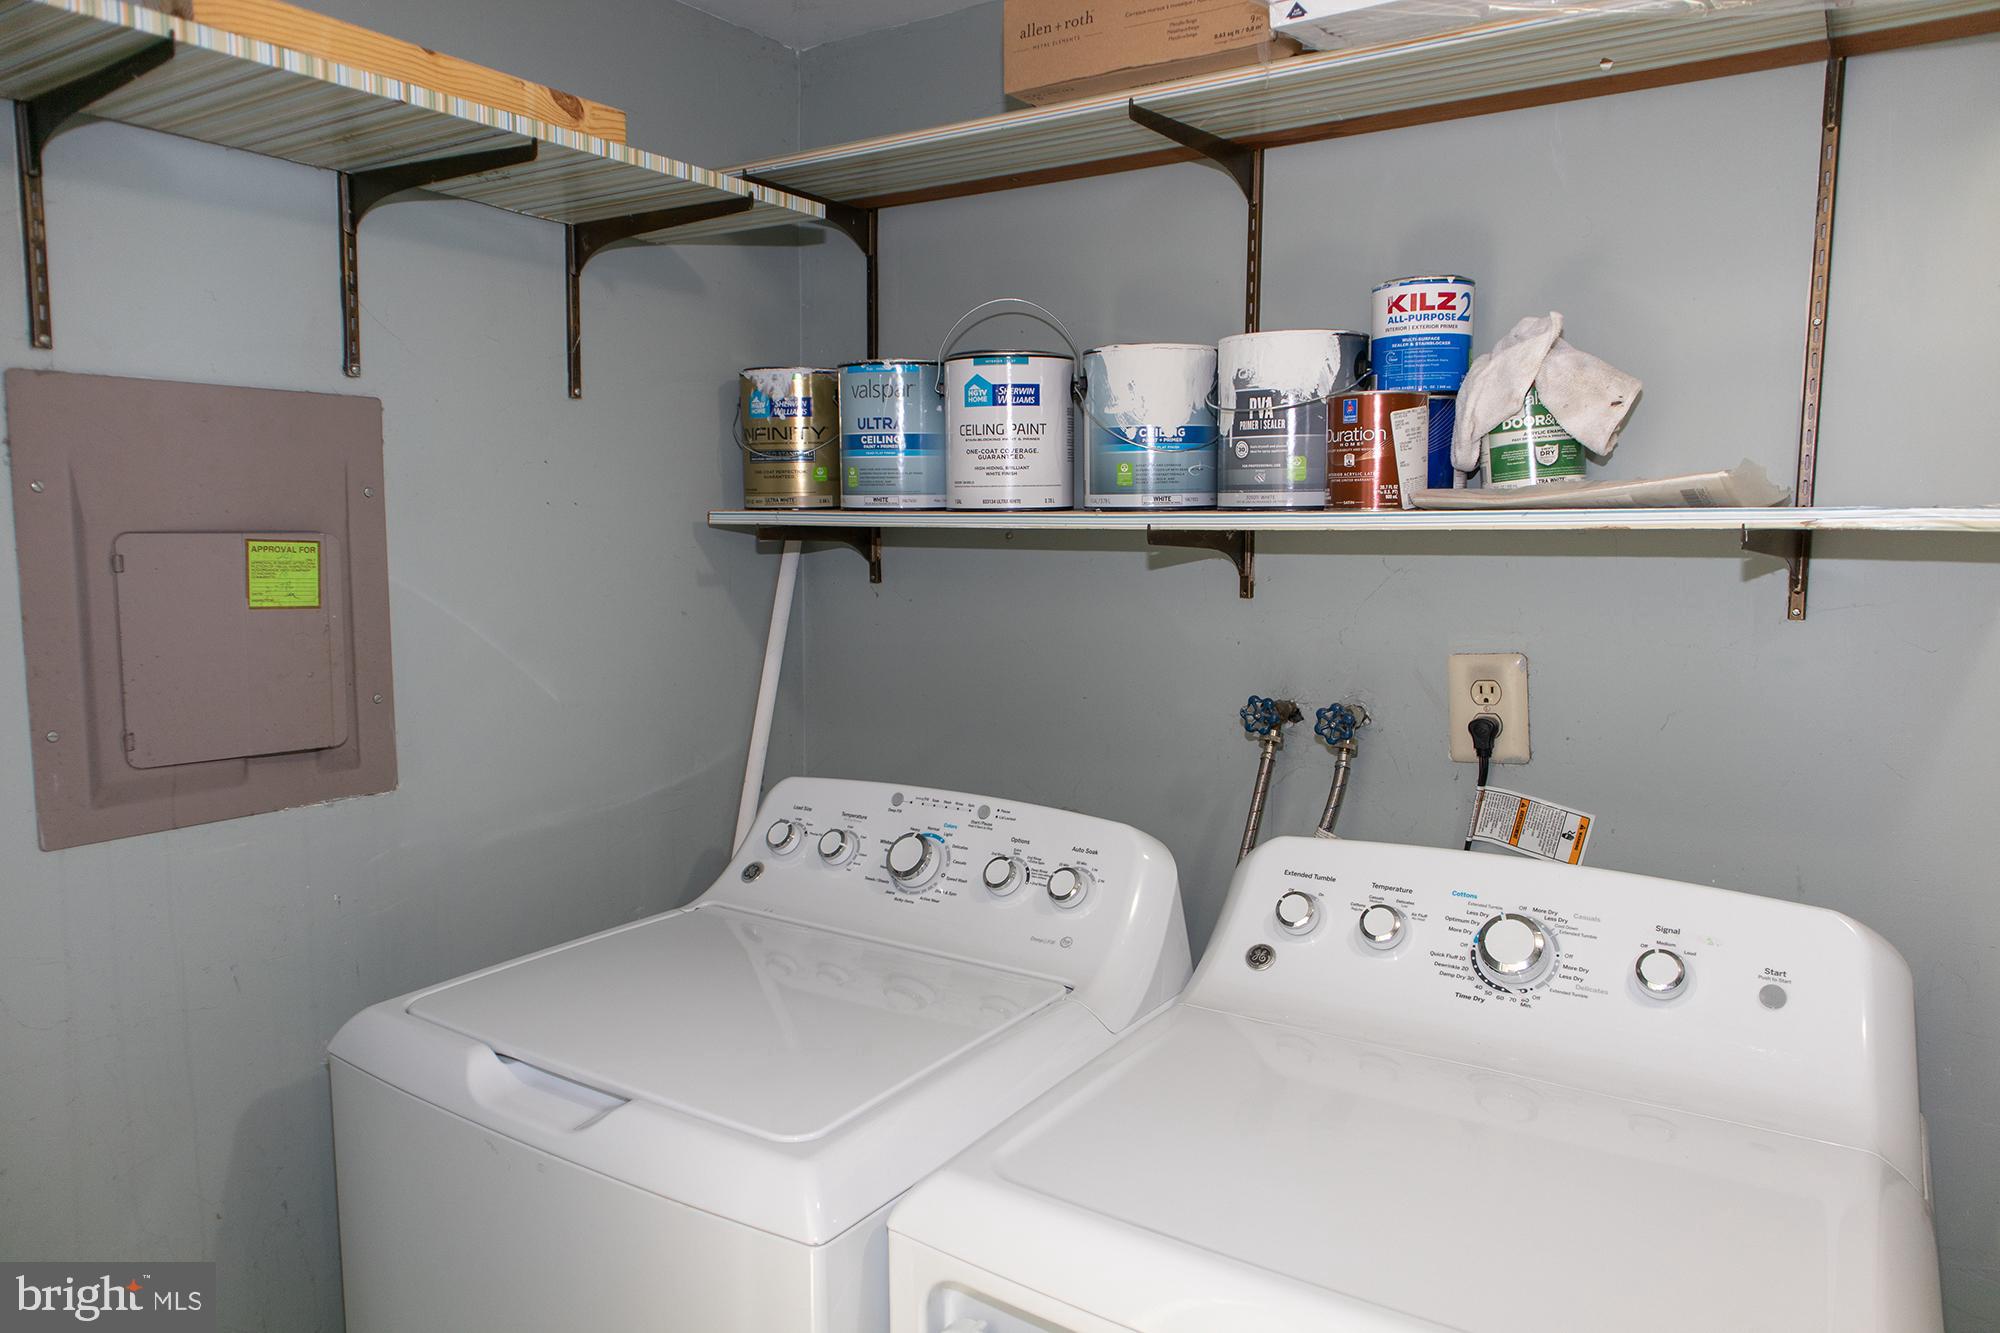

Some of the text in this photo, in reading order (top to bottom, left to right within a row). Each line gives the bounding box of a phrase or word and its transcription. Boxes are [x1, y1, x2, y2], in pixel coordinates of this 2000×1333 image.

[1020, 10, 1094, 39] allen + roth
[1388, 292, 1471, 322] KILZ 2
[1388, 313, 1456, 324] ALL-PURPOSE
[851, 379, 912, 403] valspar
[998, 395, 1035, 403] WLIAMS
[1249, 397, 1274, 419] PVA
[960, 423, 1046, 436] CEILING PAINT
[1240, 419, 1285, 430] PRIMER SEALER
[1328, 426, 1386, 443] Duration
[842, 811, 868, 820] Temperature
[1011, 837, 1030, 845] Options
[1284, 869, 1336, 882] Extended Tumble
[1372, 882, 1413, 894] Temperature
[1452, 890, 1477, 899] Cottons
[1445, 916, 1470, 924] Optimum
[1573, 913, 1600, 922] Casuals
[1655, 925, 1681, 935] Signal
[1434, 961, 1460, 970] Dewrinkle
[1764, 968, 1787, 978] Start
[1576, 984, 1608, 995] Delicates
[1455, 992, 1471, 1000] Time
